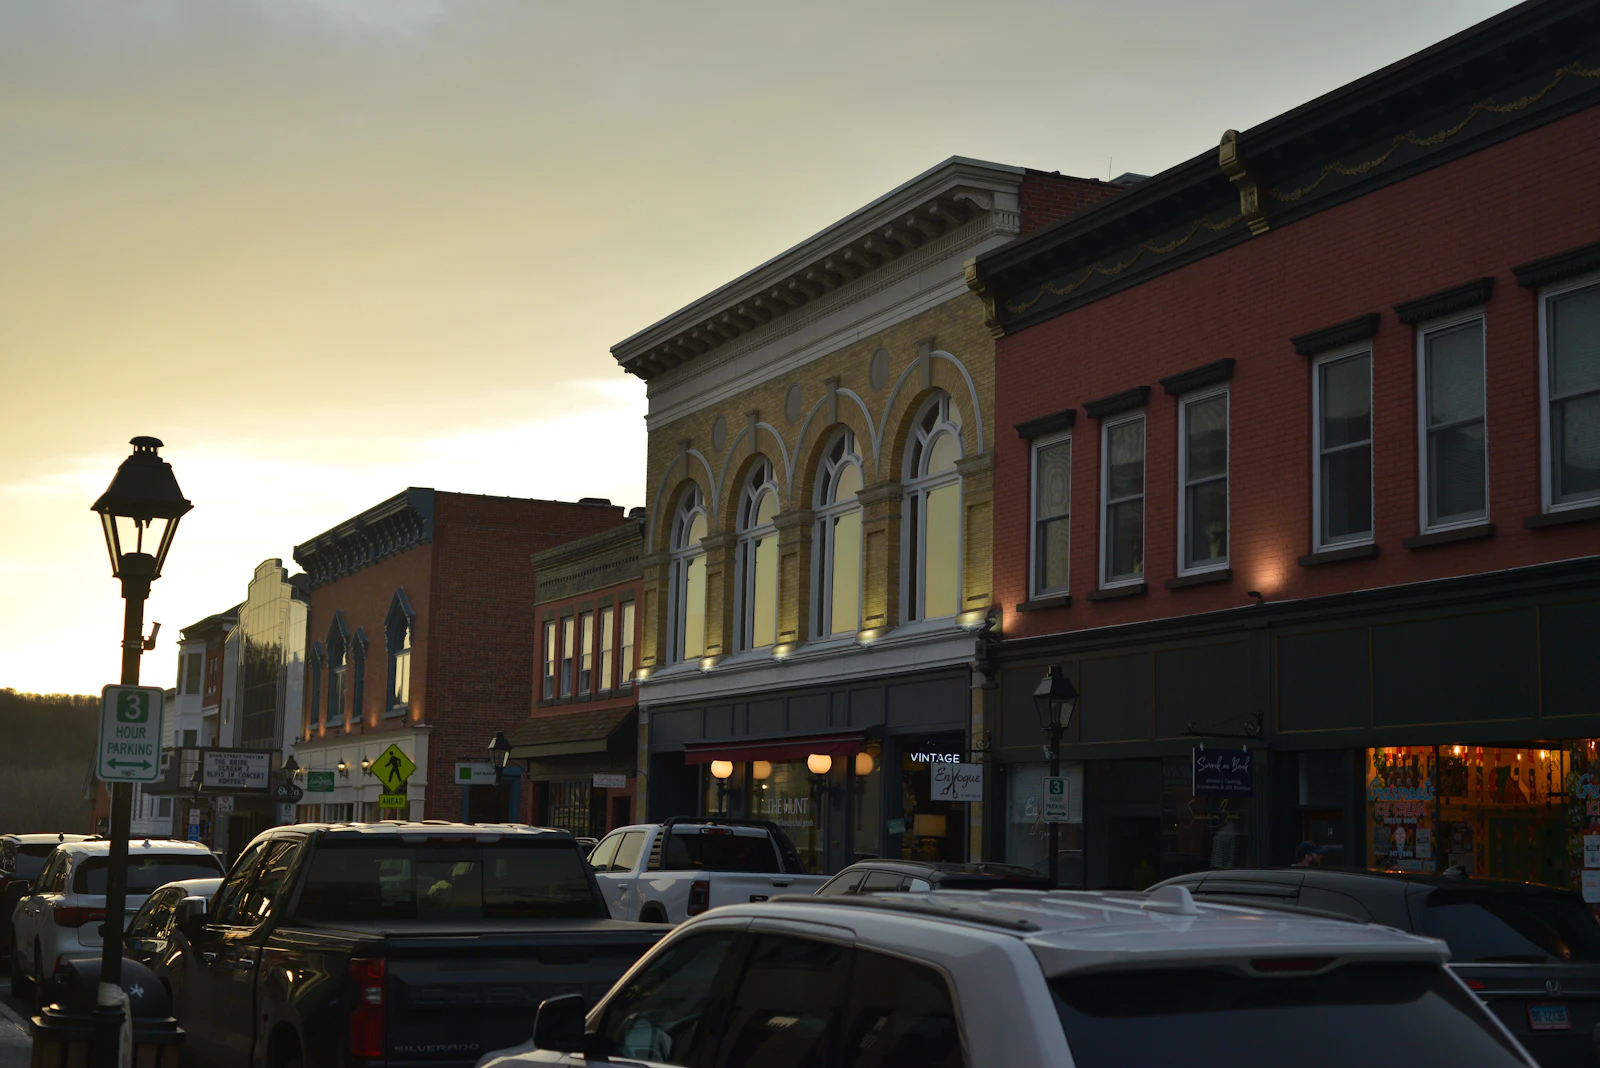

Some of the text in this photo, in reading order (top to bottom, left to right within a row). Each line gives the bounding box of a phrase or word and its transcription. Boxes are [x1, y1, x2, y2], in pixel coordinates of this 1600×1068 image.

[125, 694, 141, 720] 3
[116, 727, 147, 739] HOUR
[107, 743, 153, 756] PARKING
[910, 753, 960, 764] VINTAGE
[238, 772, 265, 780] CONCERT
[1053, 781, 1060, 794] 3
[1367, 777, 1435, 801] Grassroots
[382, 797, 404, 805] AHEAD
[767, 797, 809, 815] THE HUNT
[1374, 803, 1427, 817] ICE CREAM
[393, 1044, 480, 1053] SILVERADO
